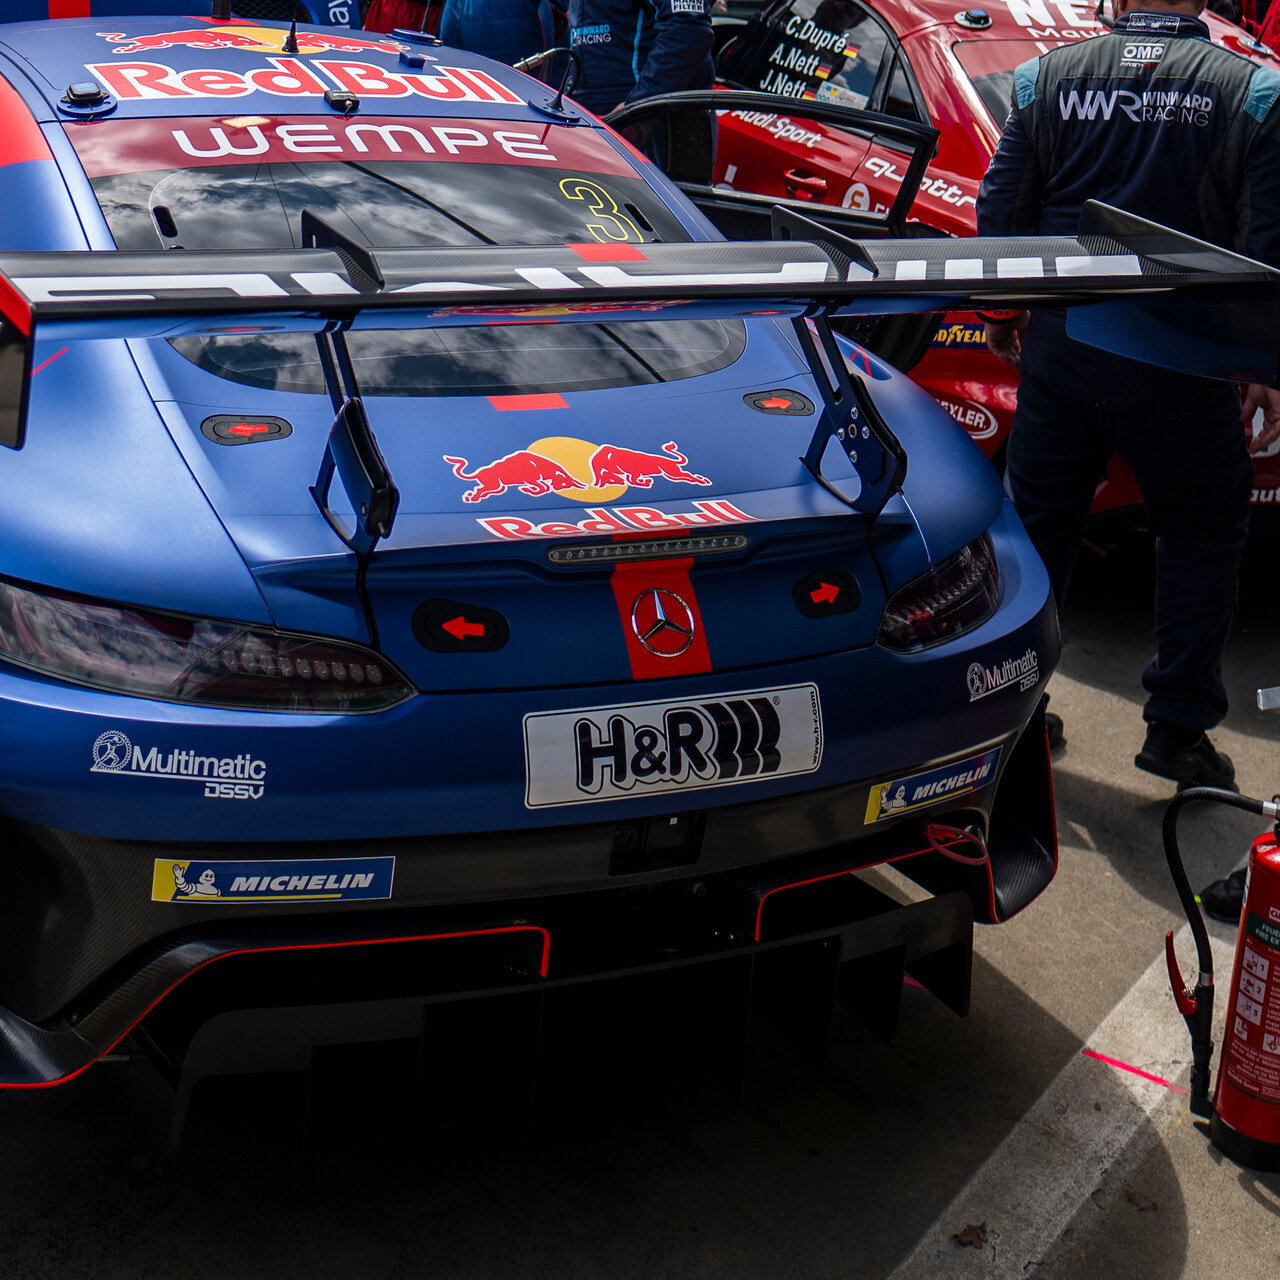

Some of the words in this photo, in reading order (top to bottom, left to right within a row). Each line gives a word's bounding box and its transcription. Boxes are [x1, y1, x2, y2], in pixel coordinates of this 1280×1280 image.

[673, 4, 703, 12] FILTER
[576, 33, 612, 45] RACING
[785, 15, 850, 53] C.Dupré
[769, 43, 820, 76] A.Nett
[1123, 46, 1165, 59] OMP
[760, 69, 806, 99] J.Nett
[1143, 91, 1213, 112] WINWARD
[1143, 105, 1210, 127] RACING
[173, 123, 558, 161] WEMPE
[731, 109, 772, 128] Audi
[770, 115, 822, 148] Sport
[558, 177, 645, 243] 3
[986, 649, 1038, 690] Multimatic
[1020, 673, 1039, 693] DSSV
[810, 690, 820, 765] www.h-r.com
[132, 745, 266, 780] Multimatic
[574, 704, 720, 795] H&R
[204, 783, 264, 800] DSSV
[912, 763, 992, 801] MICHELIN
[230, 872, 375, 893] MICHELIN
[1255, 928, 1269, 941] FIRE
